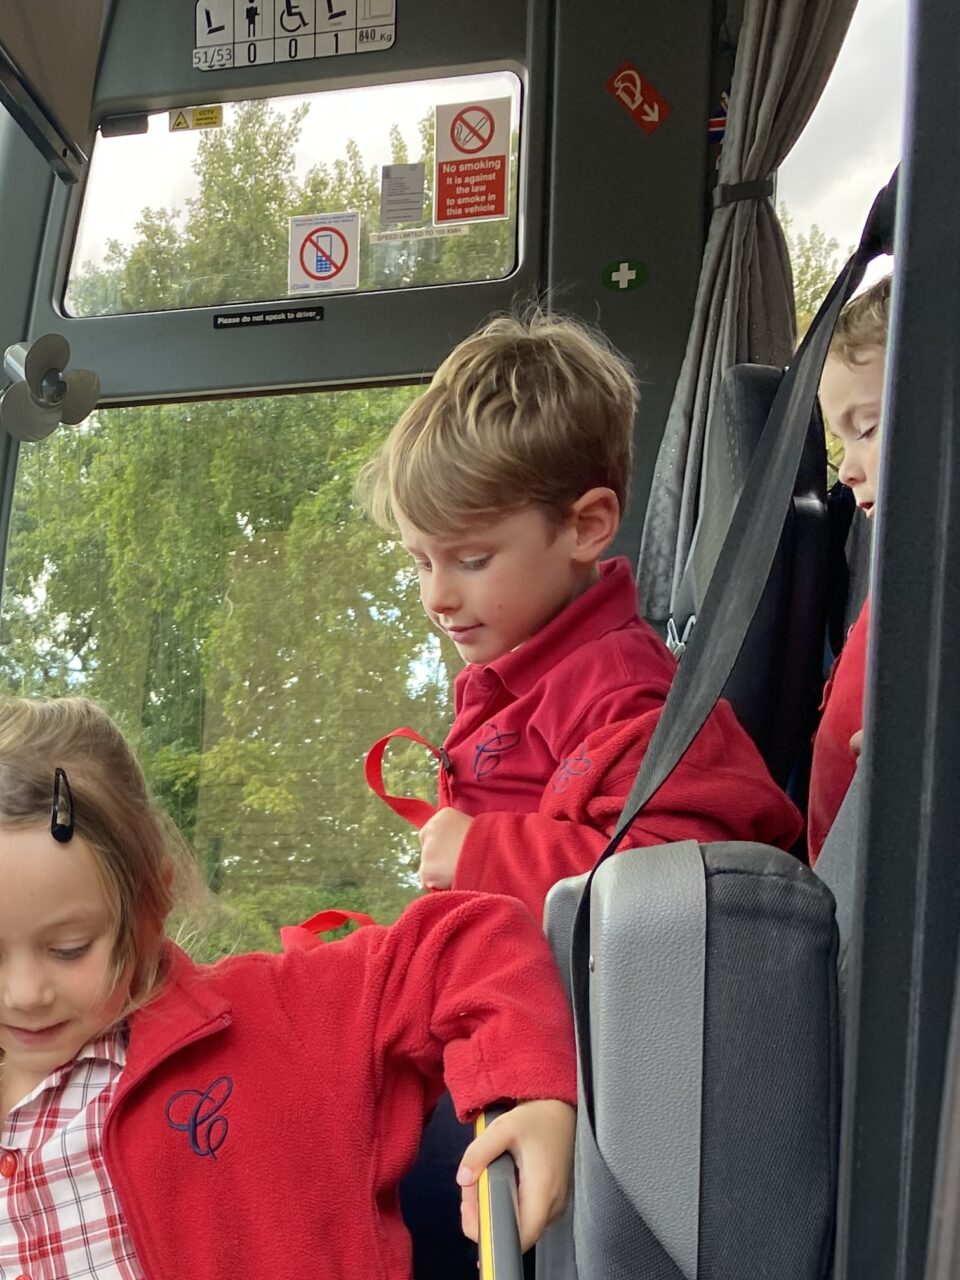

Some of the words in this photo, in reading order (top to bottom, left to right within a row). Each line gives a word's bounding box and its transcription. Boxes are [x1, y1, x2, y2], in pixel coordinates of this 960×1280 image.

[193, 48, 232, 66] 51/53
[247, 42, 256, 63] 0
[289, 38, 298, 58] 0
[333, 33, 339, 53] 1
[358, 29, 376, 42] 840
[442, 163, 457, 174] No
[458, 159, 501, 172] smoking
[446, 176, 453, 185] It
[454, 175, 463, 184] is
[464, 172, 496, 185] against
[455, 186, 470, 195] the
[471, 184, 487, 193] law
[446, 198, 455, 206] to
[457, 194, 486, 205] smoke
[487, 192, 496, 201] in
[446, 207, 463, 216] this
[464, 203, 495, 214] vehicle
[377, 233, 399, 241] SPEED
[400, 230, 423, 239] LIMITED
[424, 229, 434, 237] TO
[217, 317, 241, 325] Please
[241, 315, 251, 323] do
[252, 314, 264, 322] not
[265, 313, 286, 322] speak
[295, 311, 317, 319] driver
